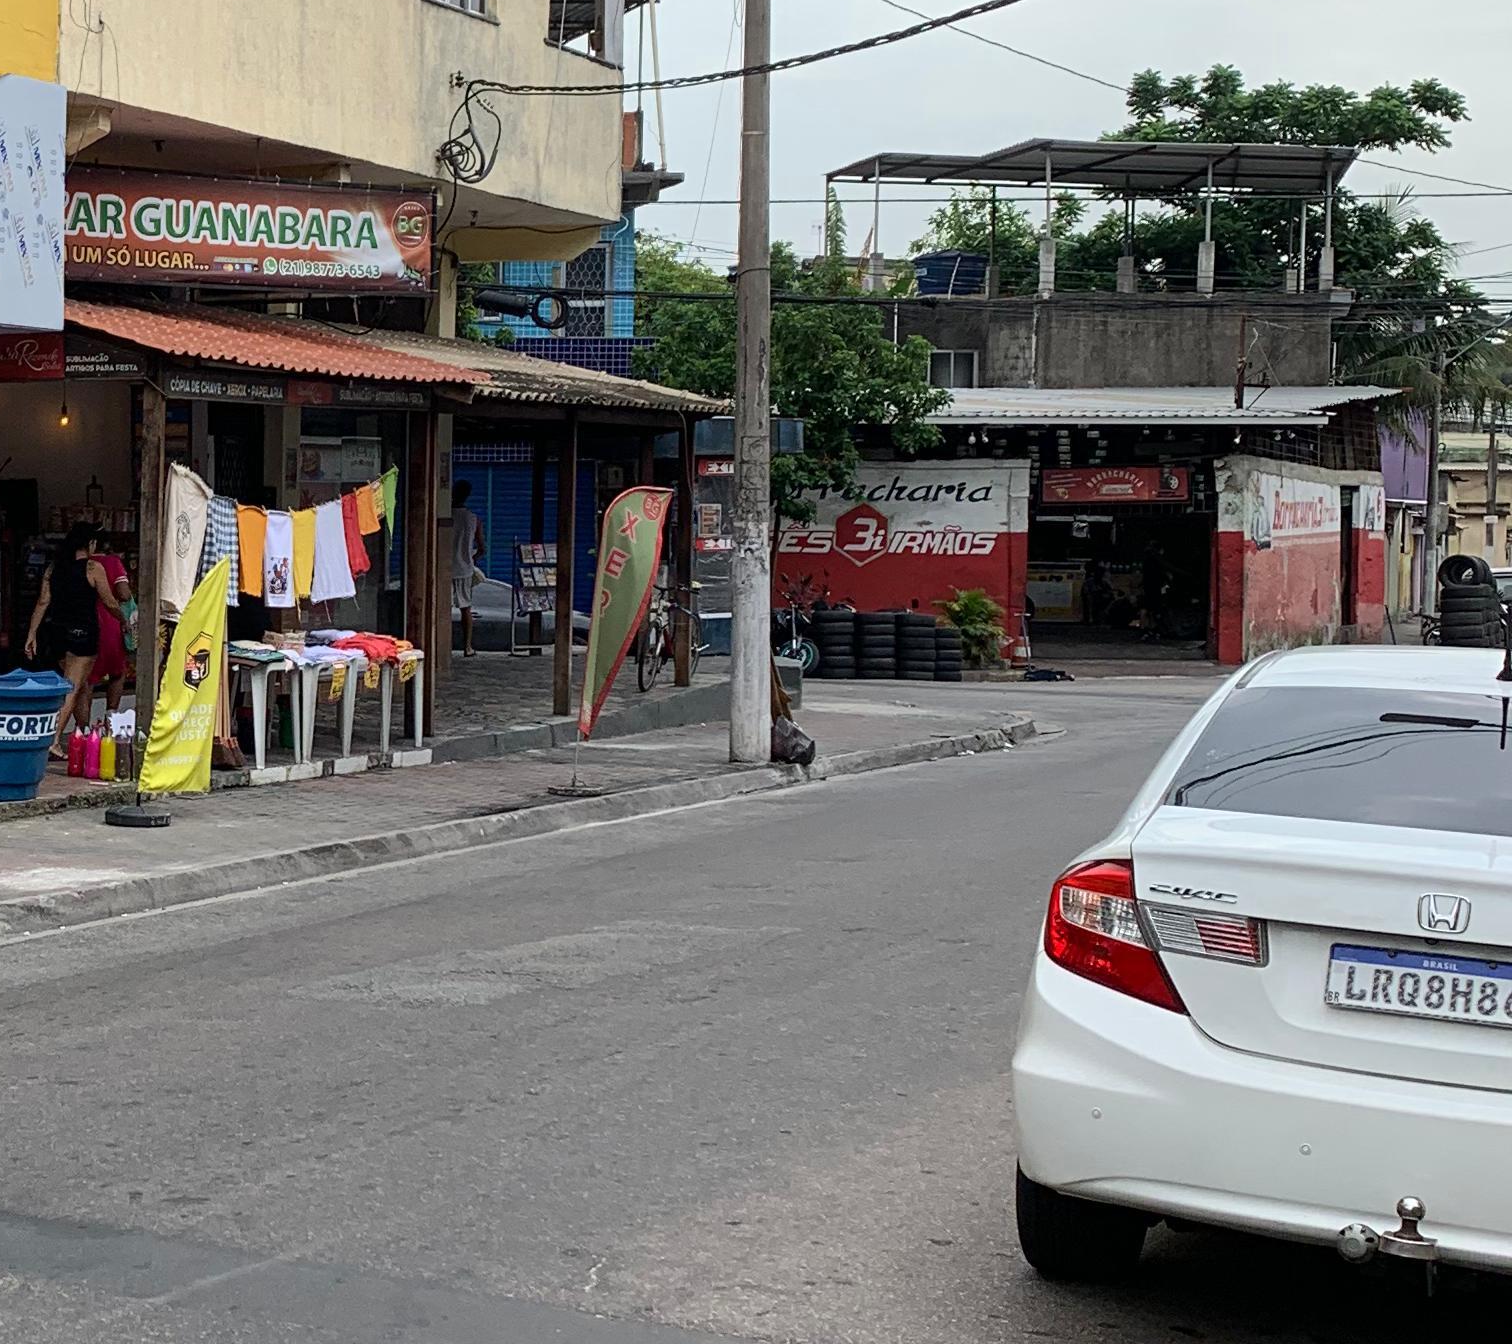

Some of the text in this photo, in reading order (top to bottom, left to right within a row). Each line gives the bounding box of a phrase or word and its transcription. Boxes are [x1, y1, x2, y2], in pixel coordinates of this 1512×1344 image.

[64, 194, 380, 250] AR GUANABARA
[396, 216, 423, 234] BG
[73, 245, 102, 264] UM
[106, 245, 129, 267] SÓ
[279, 260, 380, 278] (21)98773-6543
[95, 364, 114, 372] PARA
[115, 364, 138, 372] FESTA
[170, 376, 191, 392] CÓPIA
[191, 380, 200, 393] DE
[200, 381, 222, 395] CHAVE
[251, 384, 283, 399] PAPELARIA
[888, 524, 998, 556] IRMÃOS
[1422, 960, 1459, 972] BRASIL
[1327, 990, 1340, 1002] BR
